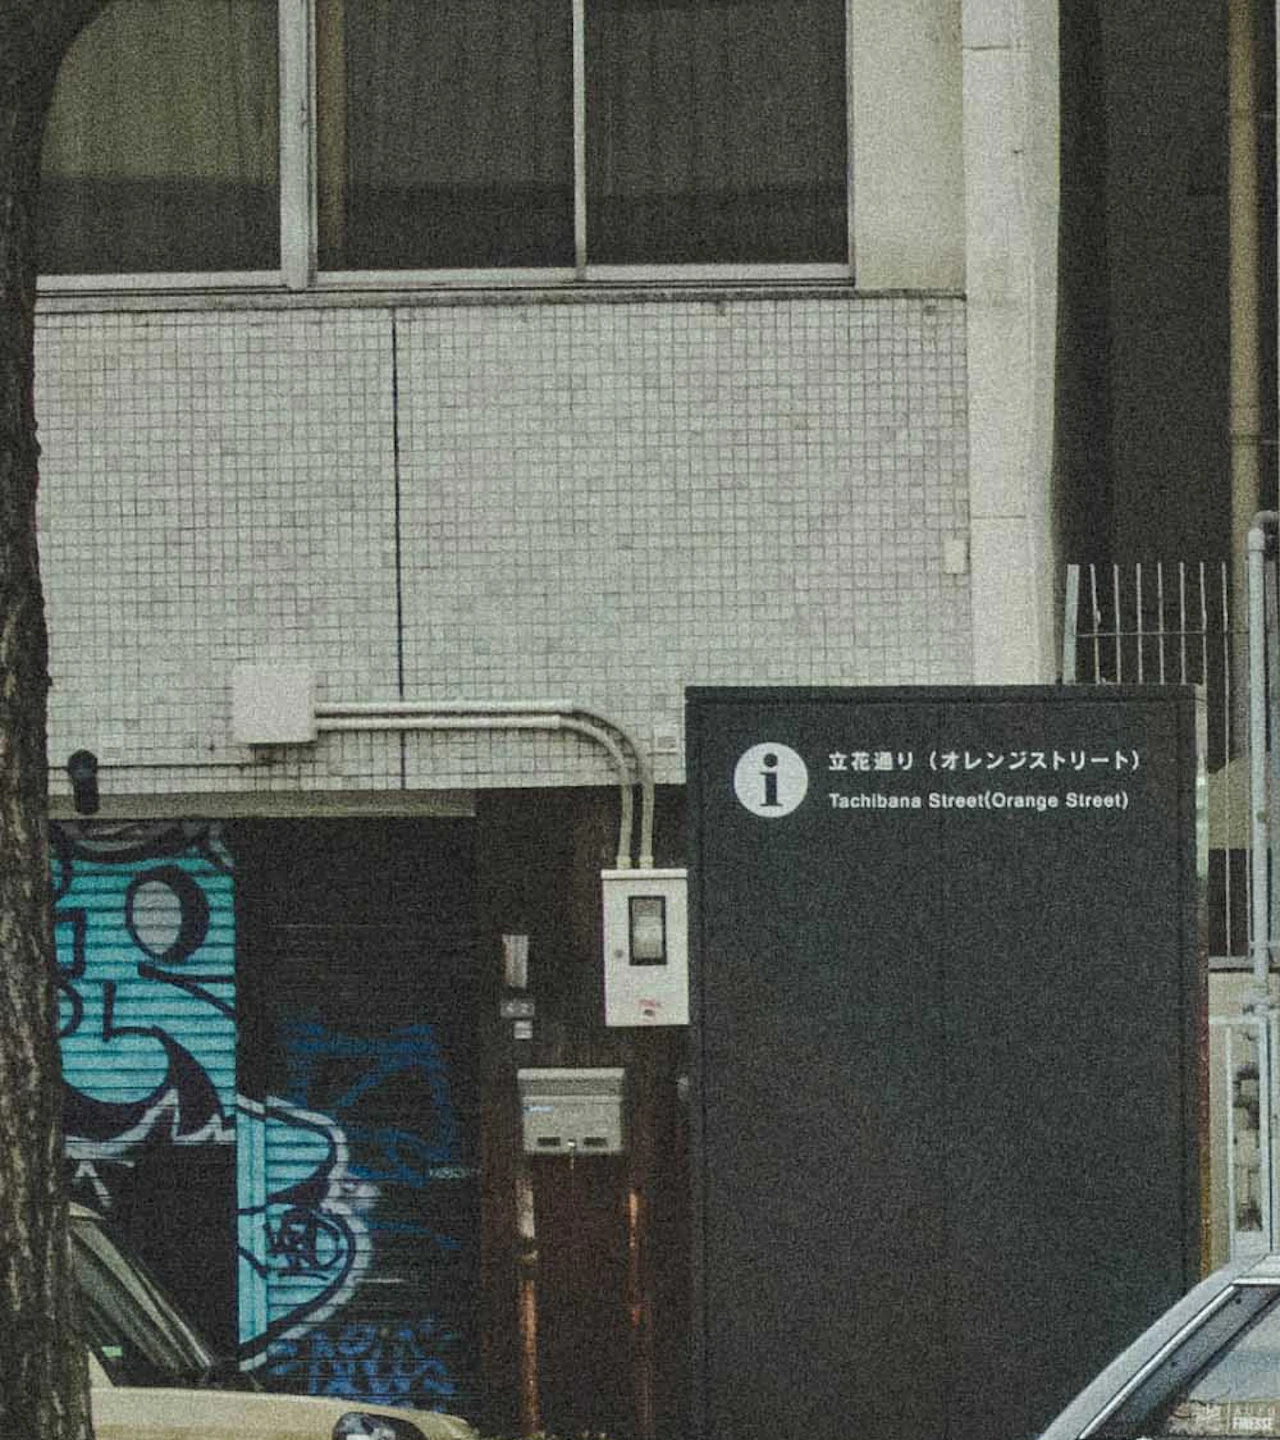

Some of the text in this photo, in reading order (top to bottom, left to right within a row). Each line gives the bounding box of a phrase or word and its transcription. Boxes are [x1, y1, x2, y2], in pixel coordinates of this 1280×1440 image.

[829, 792, 1129, 811] Tachibana Street(Orange Street)
